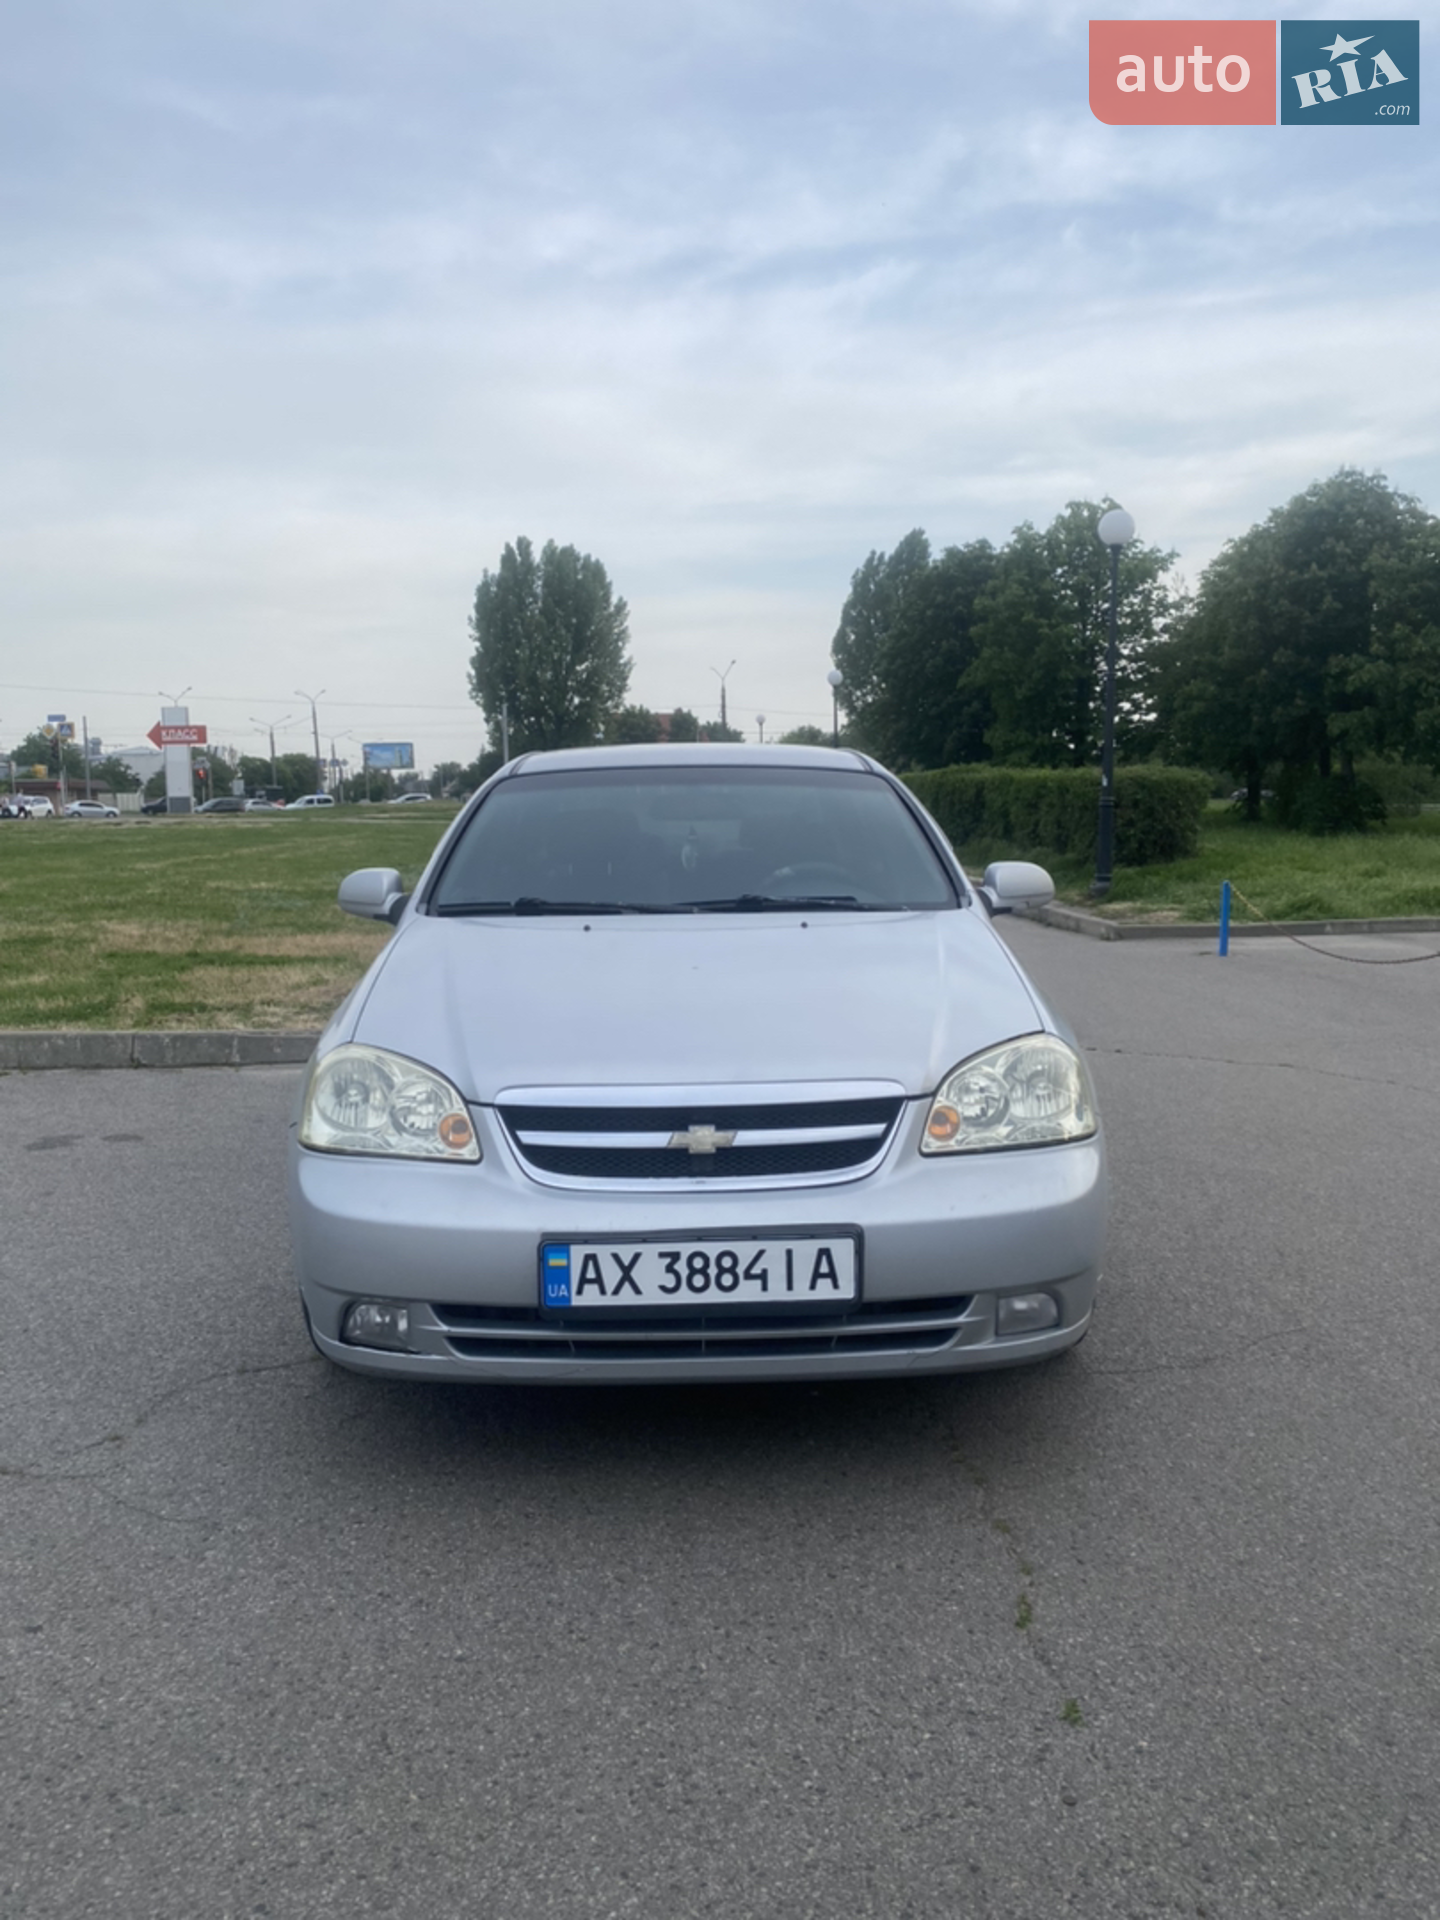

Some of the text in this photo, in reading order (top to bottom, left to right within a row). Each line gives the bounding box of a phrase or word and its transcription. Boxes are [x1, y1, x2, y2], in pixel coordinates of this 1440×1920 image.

[575, 1252, 644, 1296] AX
[657, 1249, 769, 1294] 3884
[548, 1284, 569, 1297] UA
